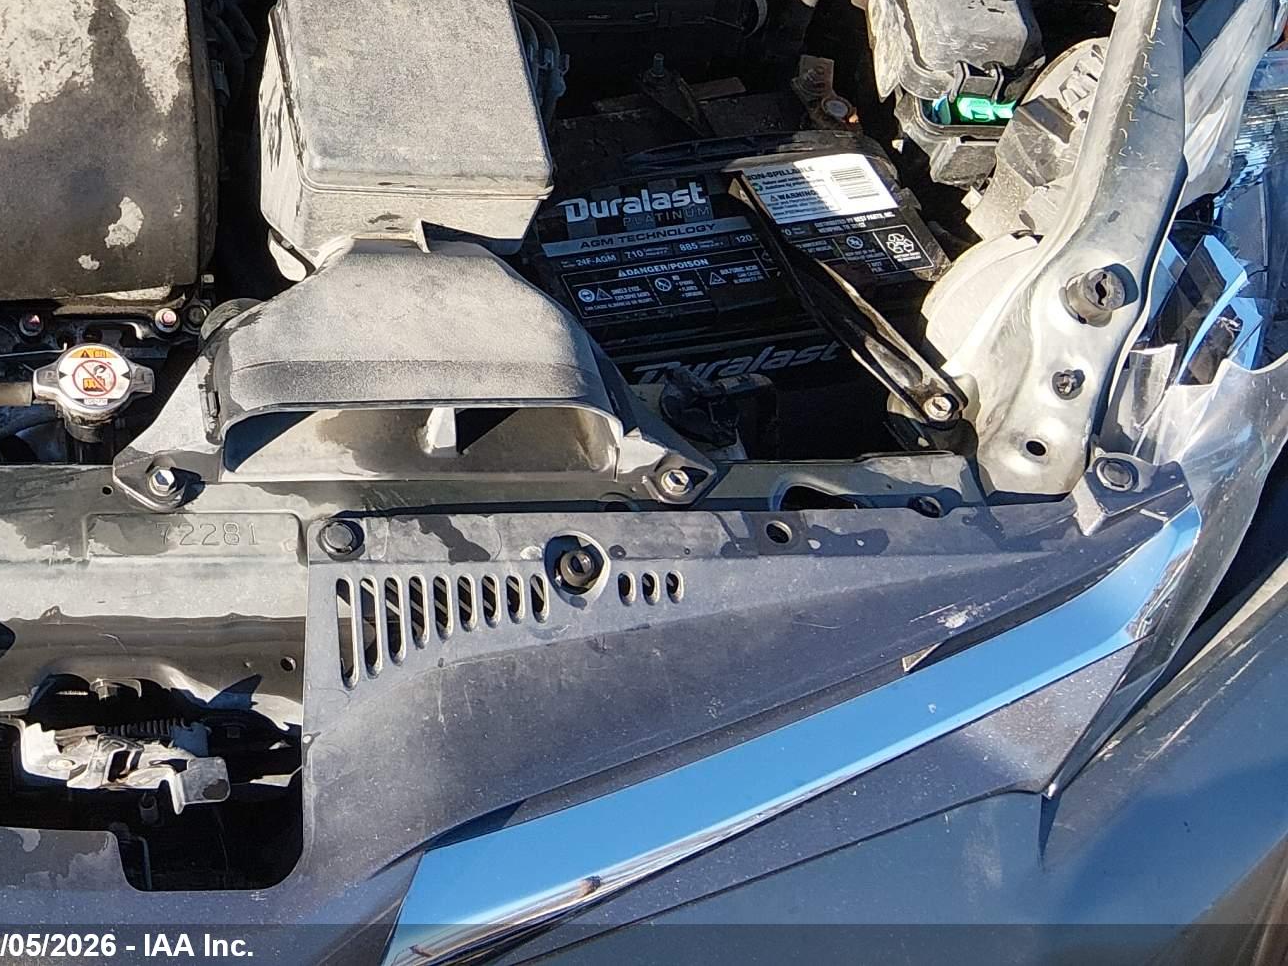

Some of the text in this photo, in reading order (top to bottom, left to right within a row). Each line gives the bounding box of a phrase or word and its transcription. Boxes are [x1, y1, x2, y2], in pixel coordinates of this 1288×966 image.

[556, 181, 707, 223] Duralast
[622, 206, 711, 227] PLATINUM
[580, 237, 614, 249] AGM
[617, 223, 717, 244] TECHNOLOGY
[624, 248, 644, 260] 710
[679, 241, 699, 252] 885
[735, 233, 753, 243] 120
[626, 258, 709, 277] DANGER/POISON
[155, 521, 260, 546] 72281
